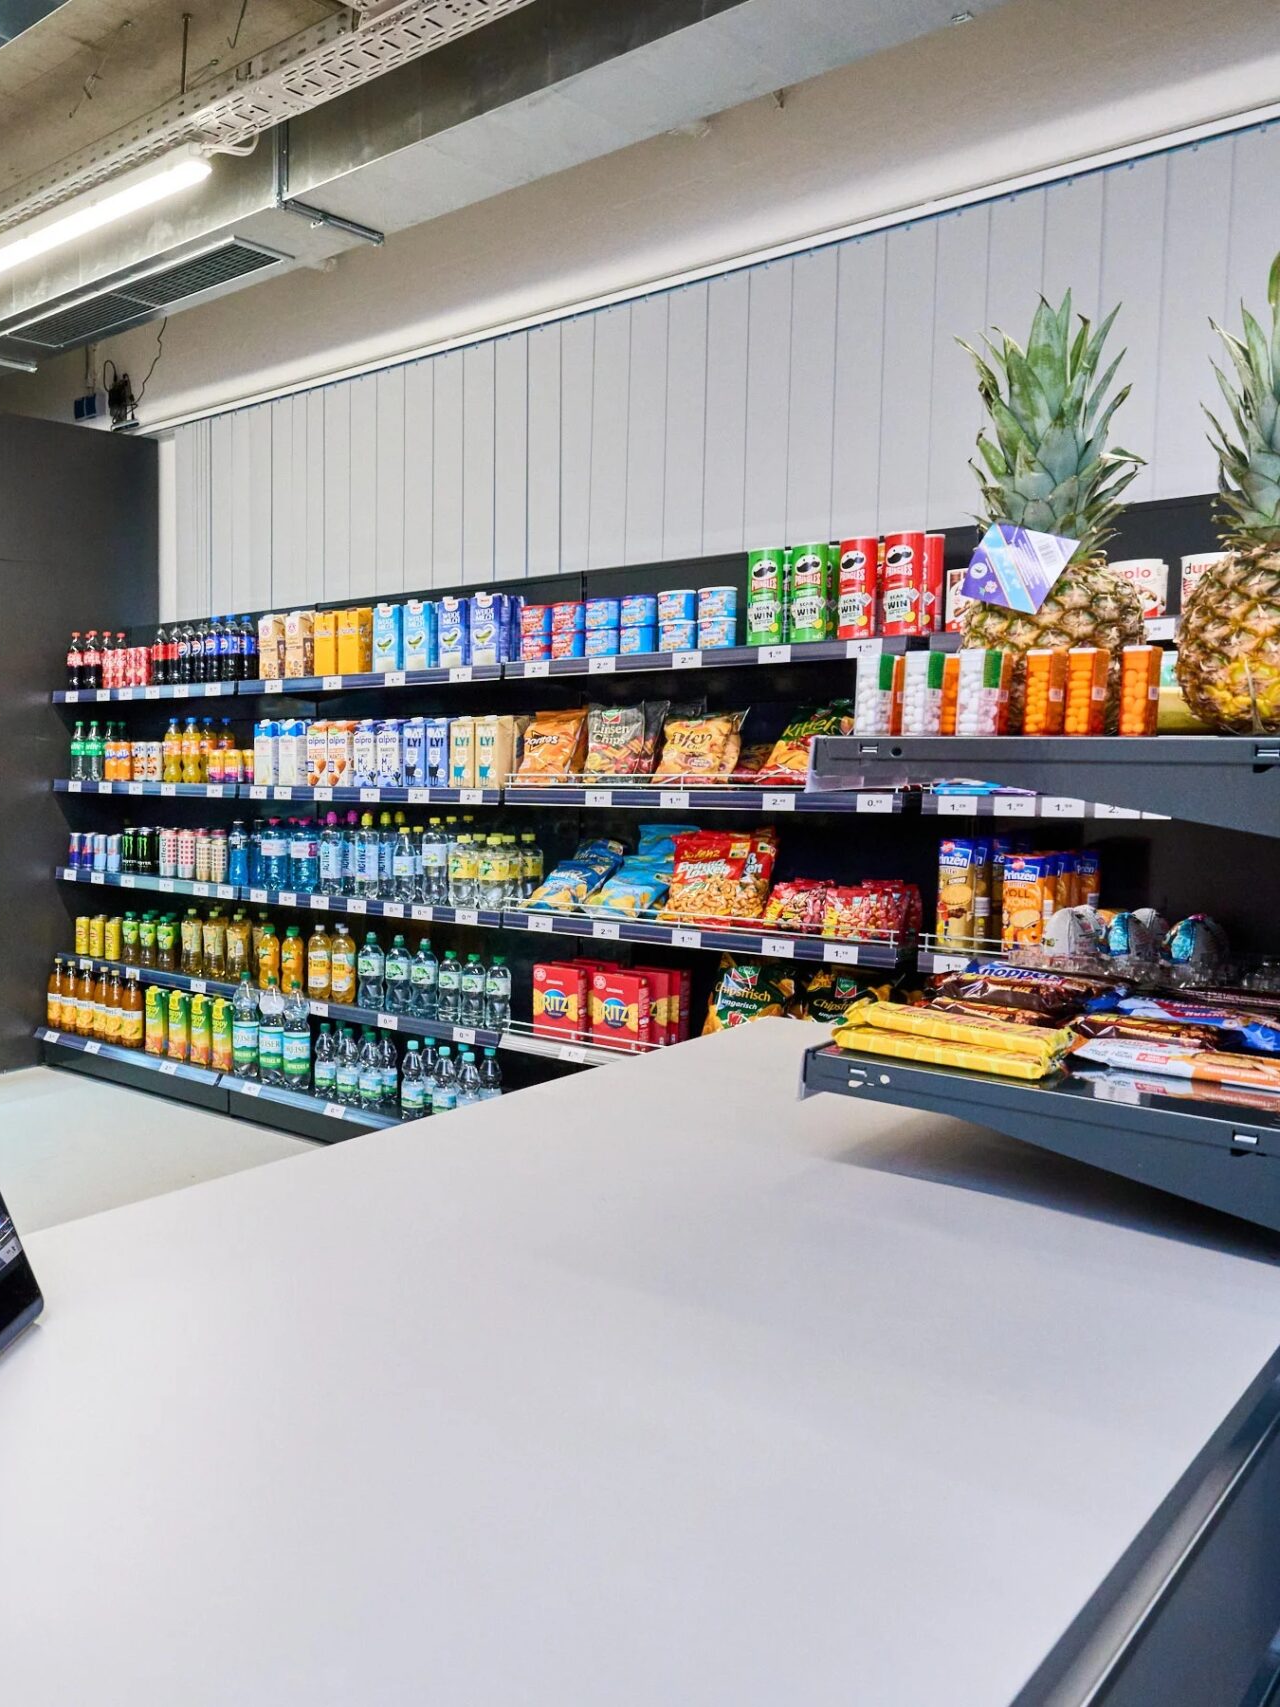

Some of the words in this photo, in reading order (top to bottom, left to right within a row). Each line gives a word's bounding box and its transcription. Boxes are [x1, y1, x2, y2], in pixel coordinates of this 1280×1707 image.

[1125, 566, 1152, 579] plo
[841, 604, 860, 613] WIN
[887, 600, 908, 609] WIN
[754, 611, 773, 620] WIN
[797, 607, 817, 616] WIN
[592, 723, 629, 735] Linsen
[309, 738, 325, 747] alpro
[329, 738, 345, 746] alpro
[355, 737, 371, 745] alpro
[379, 736, 397, 745] alpro
[715, 981, 771, 1002] Chipsfrisch
[542, 997, 569, 1013] RITZ
[722, 1000, 757, 1010] ungarisch
[813, 999, 853, 1011] Chipsfri
[602, 1002, 629, 1018] RITZ
